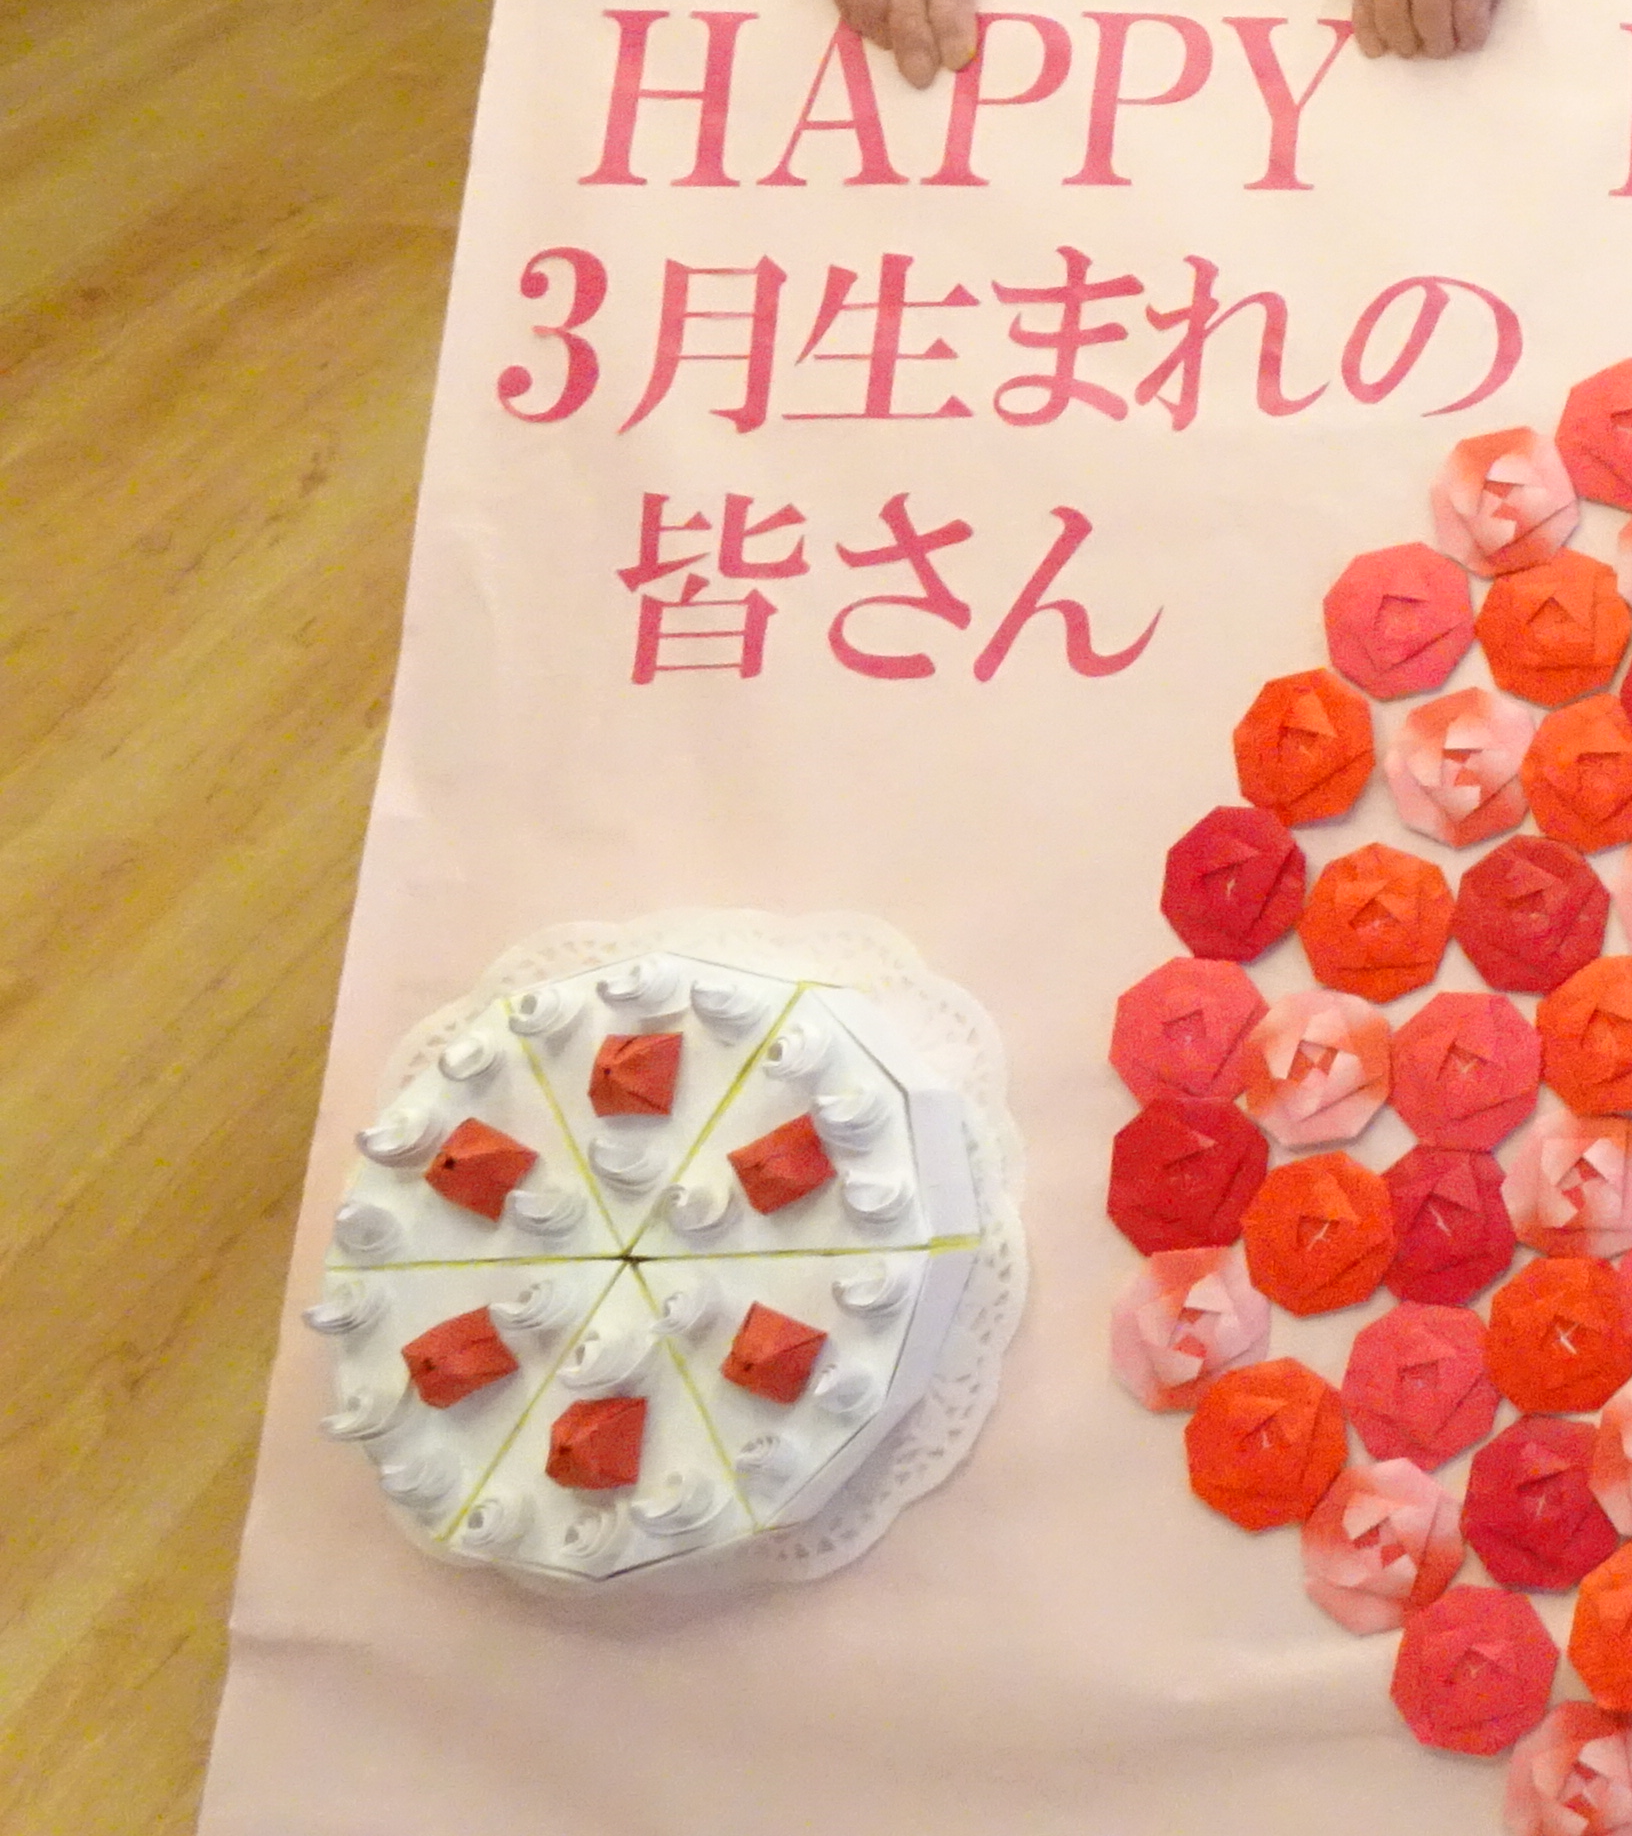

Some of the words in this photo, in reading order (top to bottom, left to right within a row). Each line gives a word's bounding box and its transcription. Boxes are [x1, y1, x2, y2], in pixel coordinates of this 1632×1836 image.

[578, 9, 1354, 191] HAPPY
[497, 246, 1524, 433] 3月生まれの
[616, 492, 1162, 686] 皆さん
